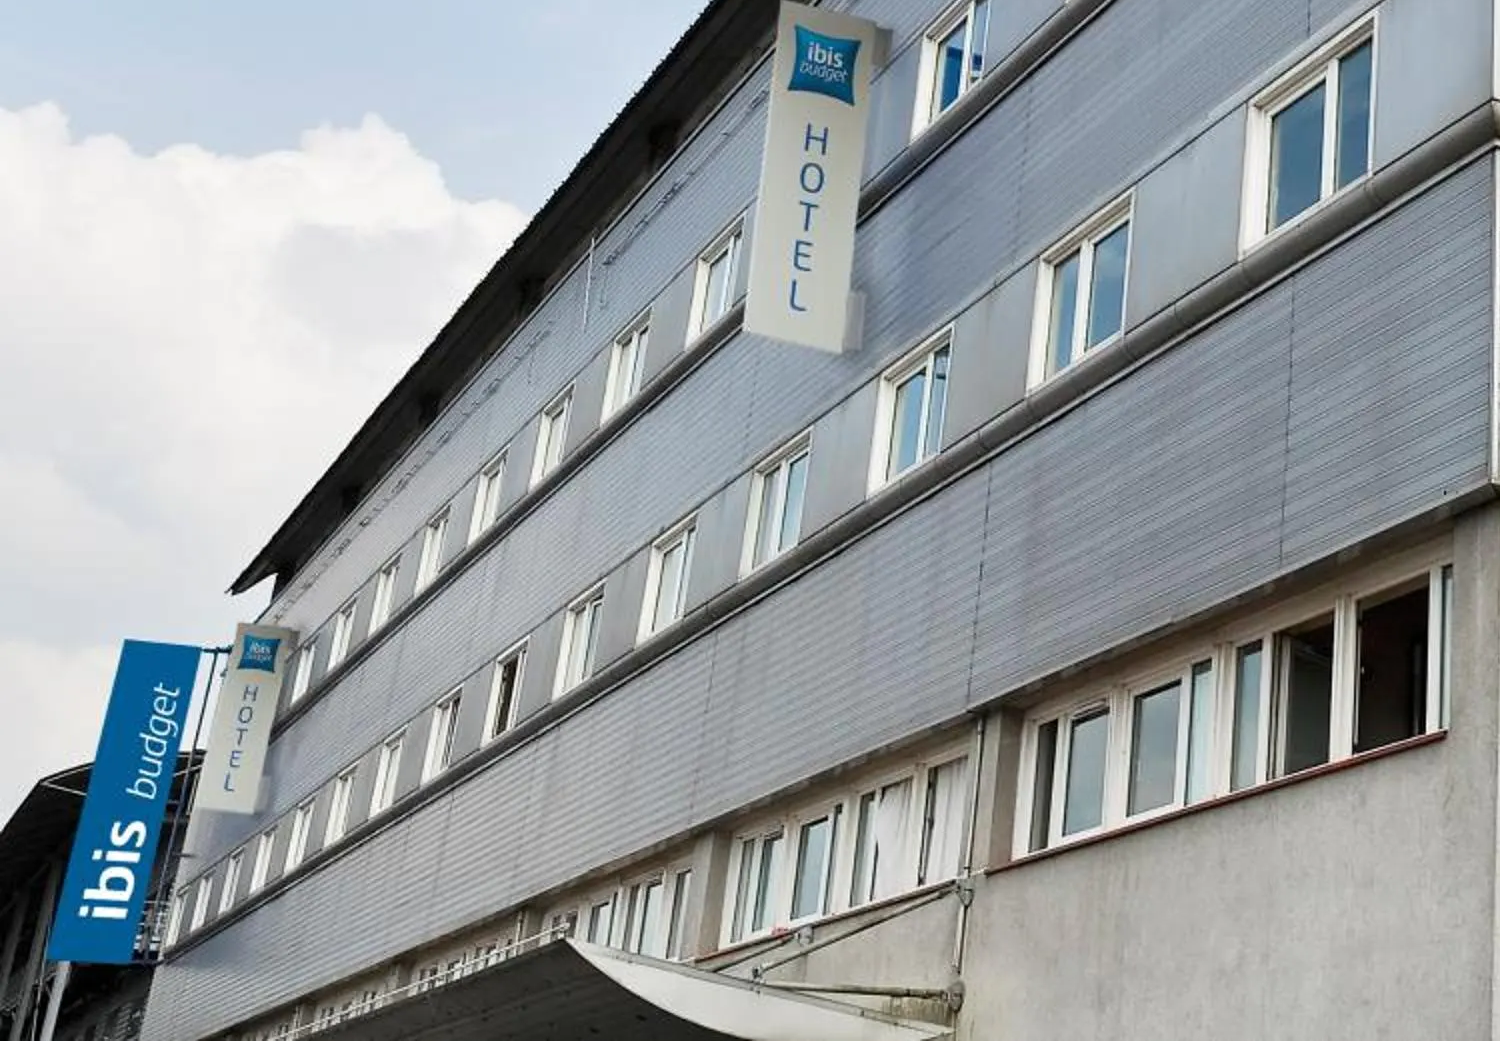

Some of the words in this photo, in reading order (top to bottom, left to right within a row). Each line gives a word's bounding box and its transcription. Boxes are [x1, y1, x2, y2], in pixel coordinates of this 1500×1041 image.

[799, 60, 848, 84] budget
[808, 41, 844, 68] ibis
[789, 123, 829, 312] HOTEL
[224, 686, 259, 792] HOTEL
[79, 820, 147, 920] ibis
[126, 682, 180, 800] budget
